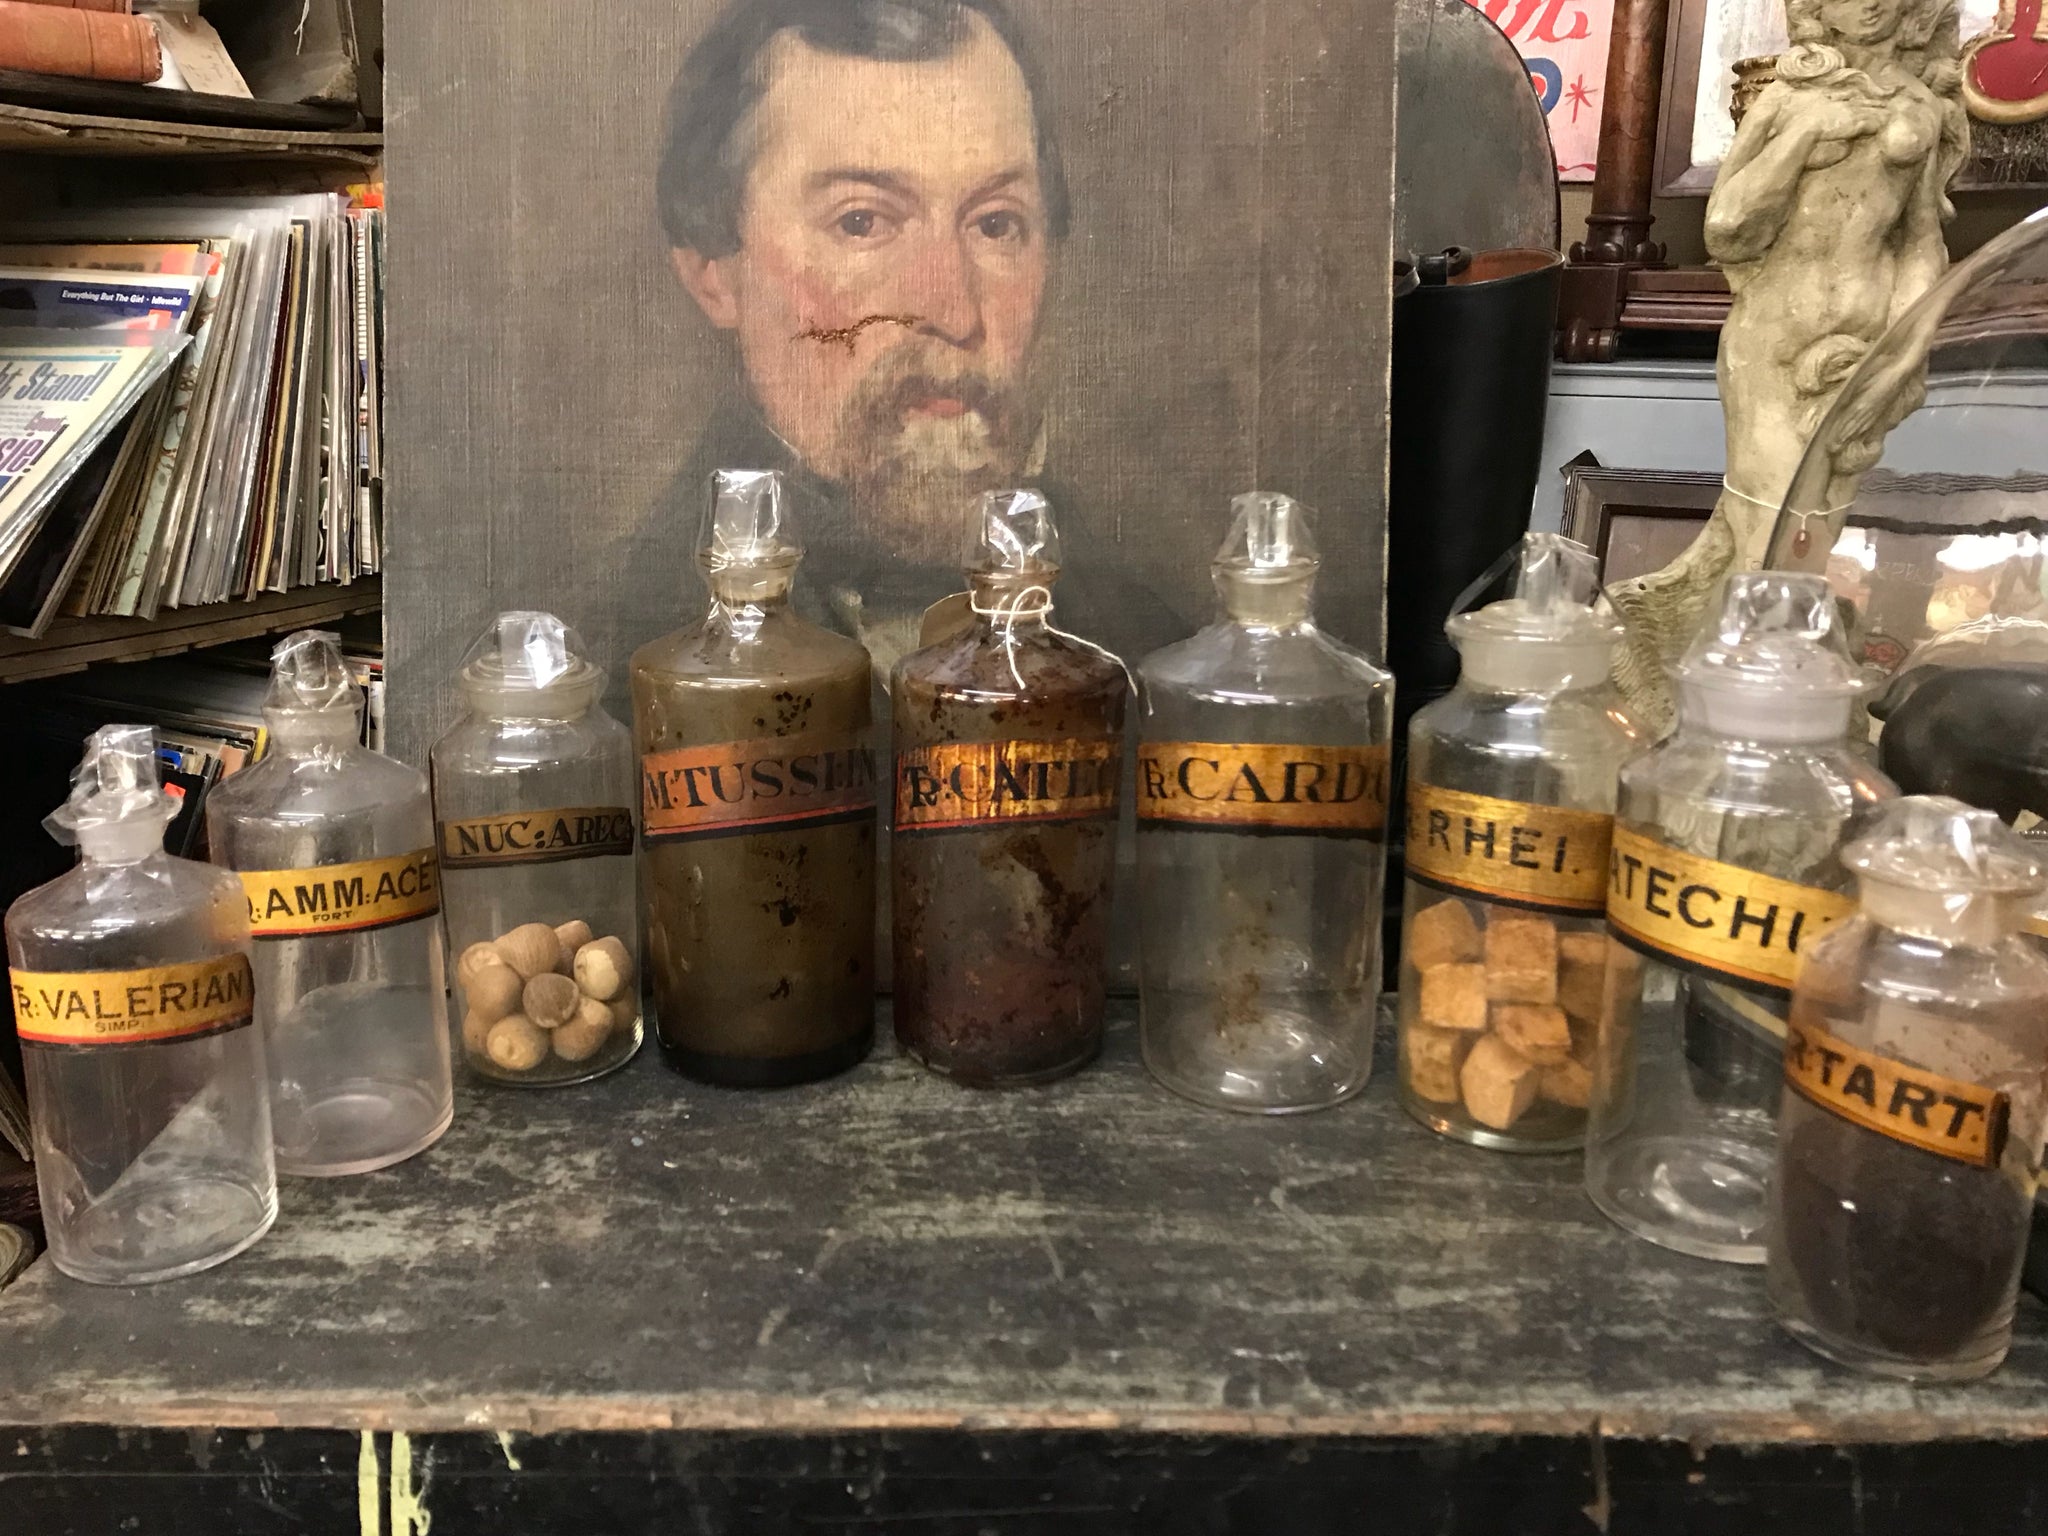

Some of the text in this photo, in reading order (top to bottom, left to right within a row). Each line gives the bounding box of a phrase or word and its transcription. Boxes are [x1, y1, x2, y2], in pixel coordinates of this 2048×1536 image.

[62, 290, 100, 302] Everything
[100, 292, 115, 301] But
[115, 293, 129, 302] The
[130, 294, 145, 303] Girl
[14, 362, 118, 402] Stand!
